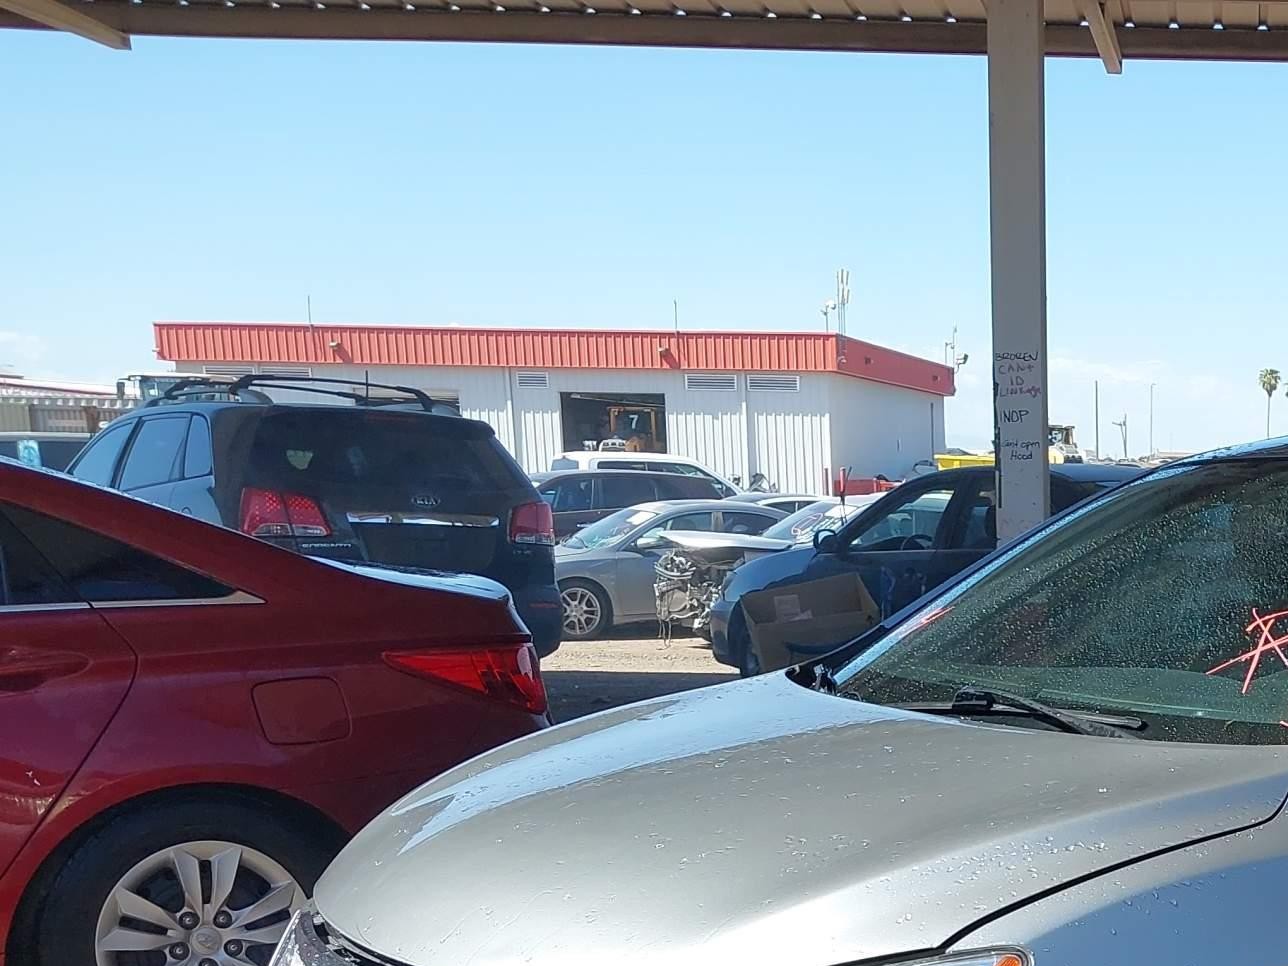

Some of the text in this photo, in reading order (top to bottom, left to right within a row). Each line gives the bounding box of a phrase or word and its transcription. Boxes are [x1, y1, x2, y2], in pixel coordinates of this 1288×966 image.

[995, 351, 1039, 361] BROKEN
[1010, 375, 1025, 386] ID
[628, 414, 639, 430] 7
